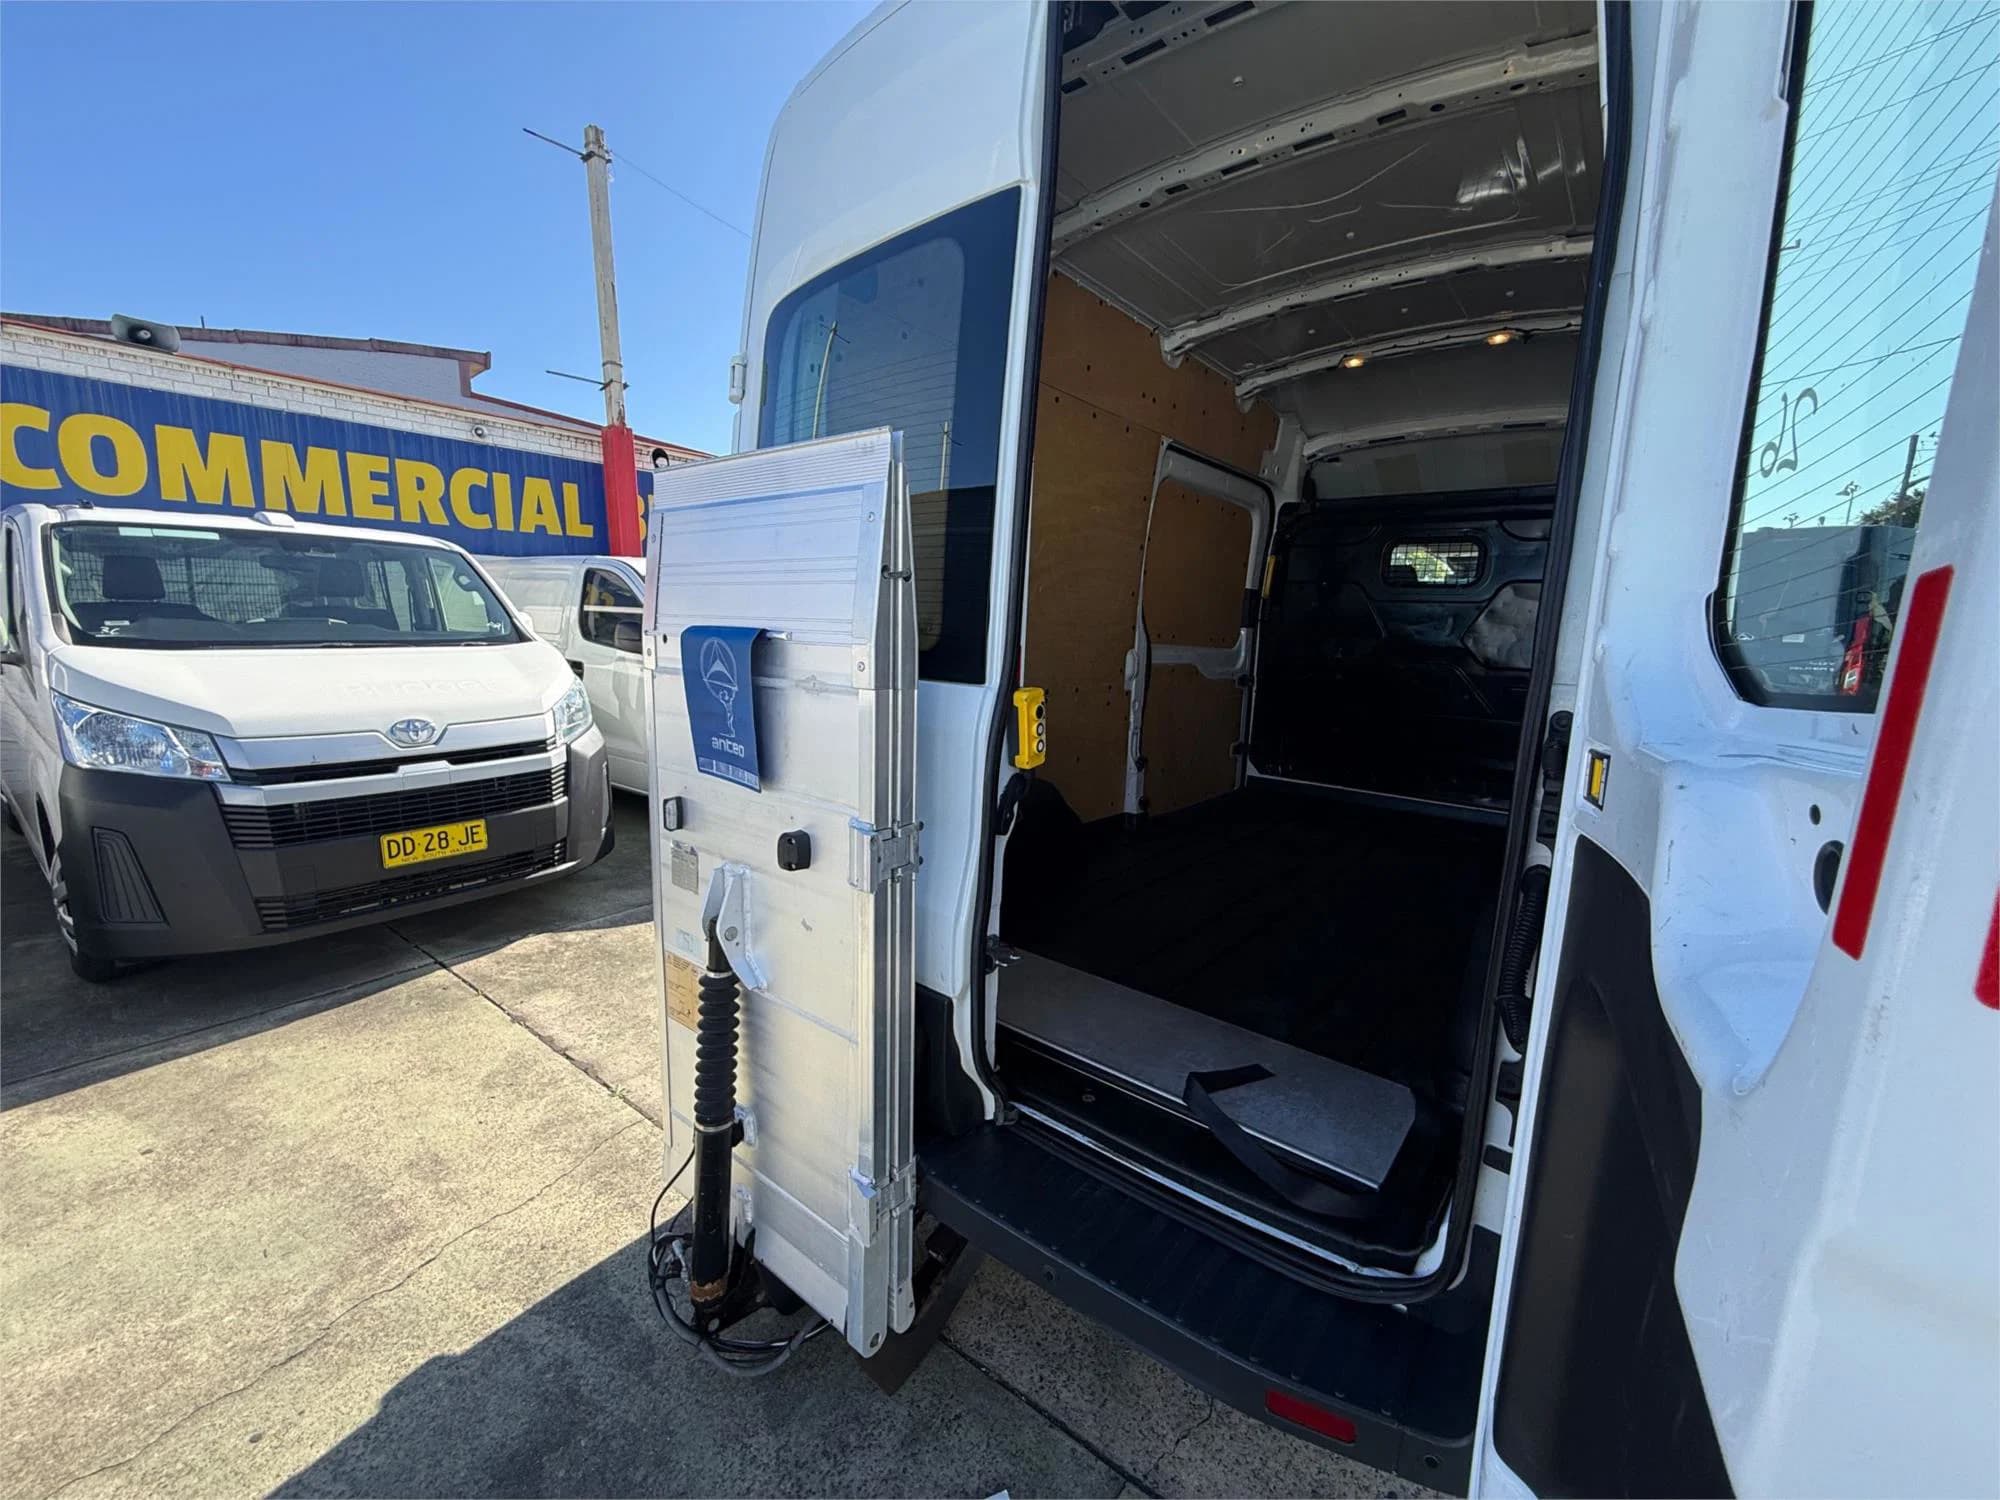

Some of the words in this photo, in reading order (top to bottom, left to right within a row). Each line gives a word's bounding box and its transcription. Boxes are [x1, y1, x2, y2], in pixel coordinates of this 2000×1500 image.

[0, 402, 594, 538] COMMERCIAL
[711, 736, 745, 758] anteo
[387, 836, 416, 859] DD
[423, 830, 450, 853] 28
[458, 824, 483, 846] JE
